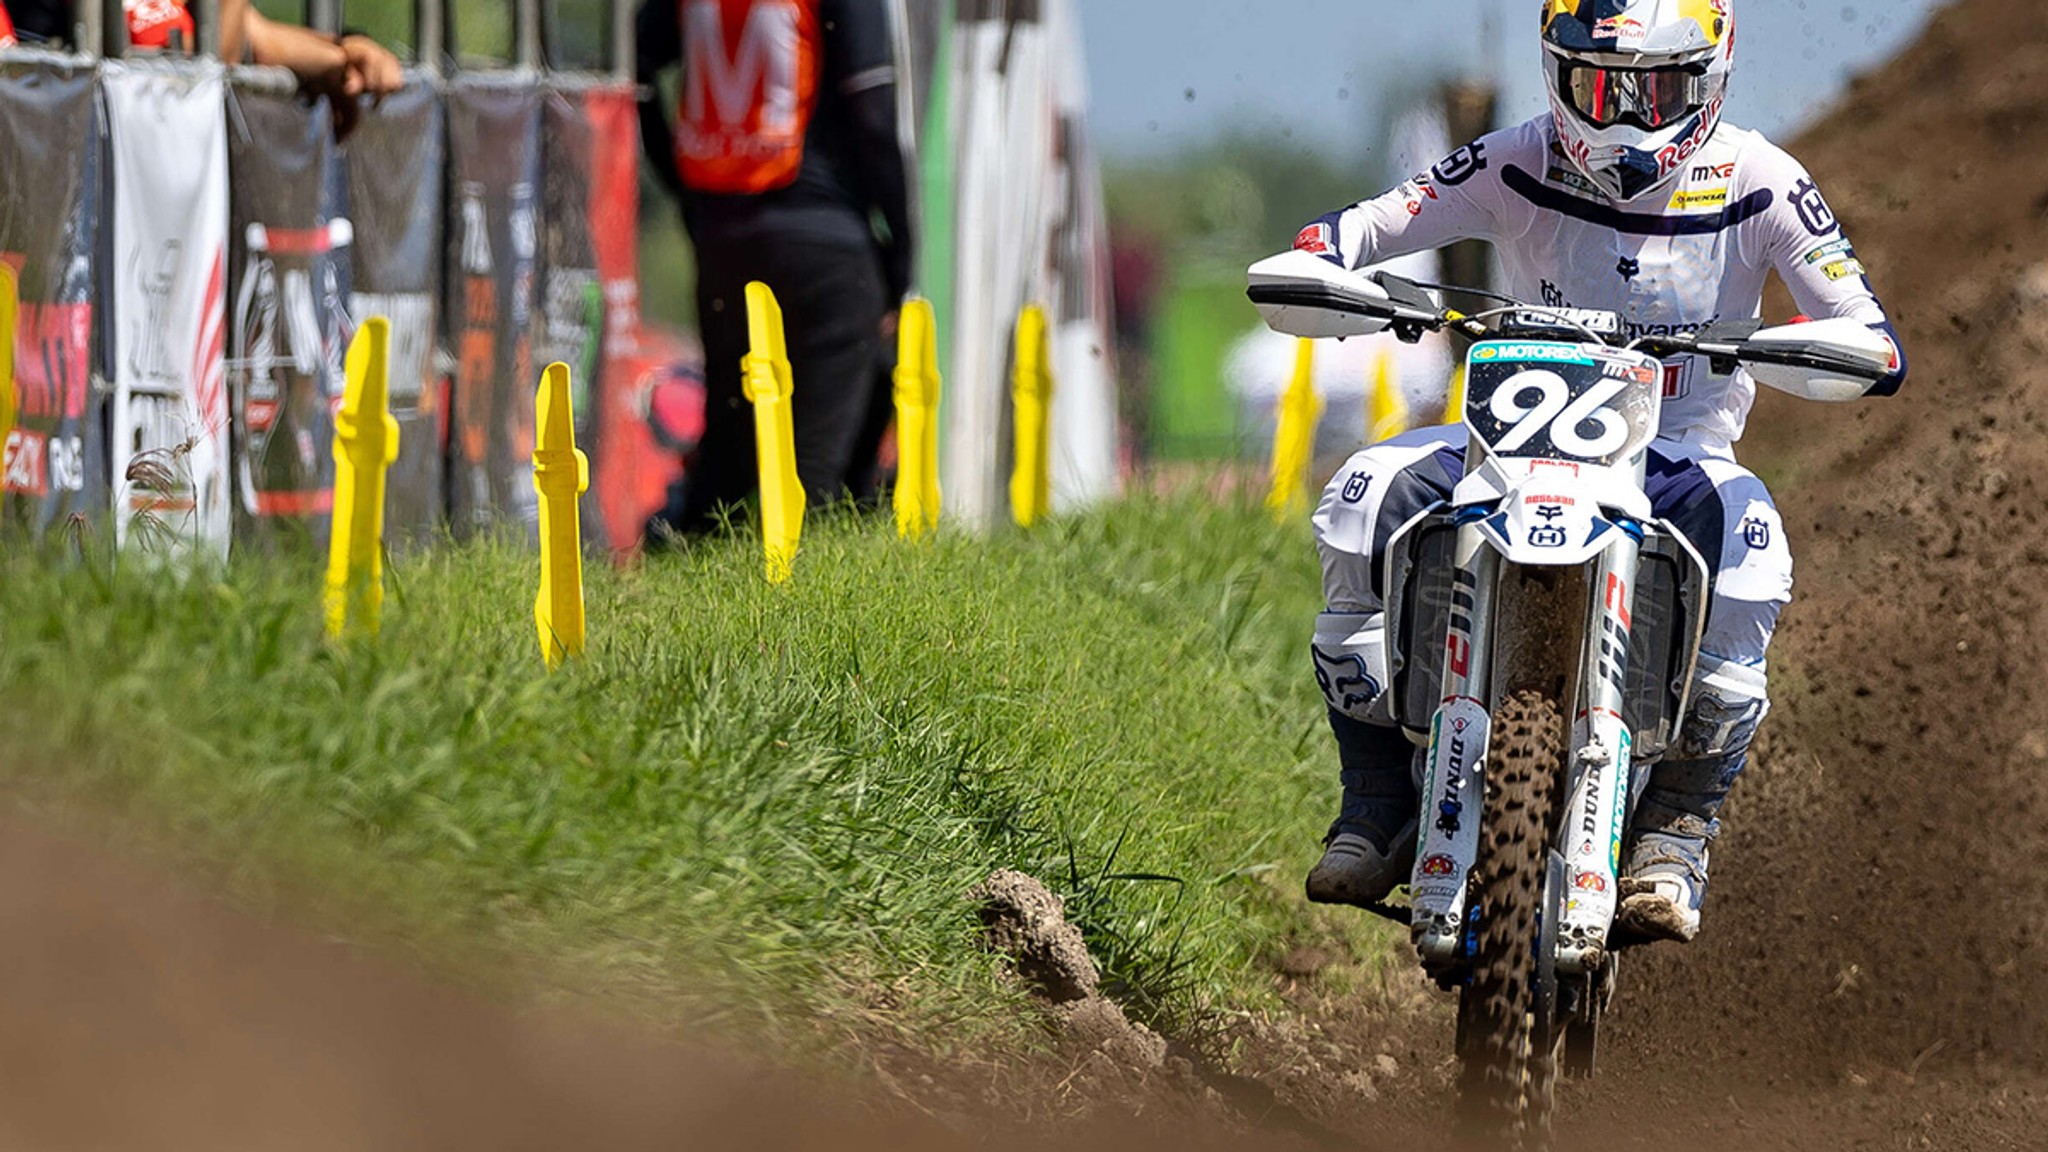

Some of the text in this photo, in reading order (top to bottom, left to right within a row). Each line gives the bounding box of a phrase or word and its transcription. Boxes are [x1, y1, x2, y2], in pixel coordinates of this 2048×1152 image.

[1657, 108, 1708, 177] Red
[1498, 345, 1583, 361] MOTOREX
[1490, 369, 1630, 458] 96
